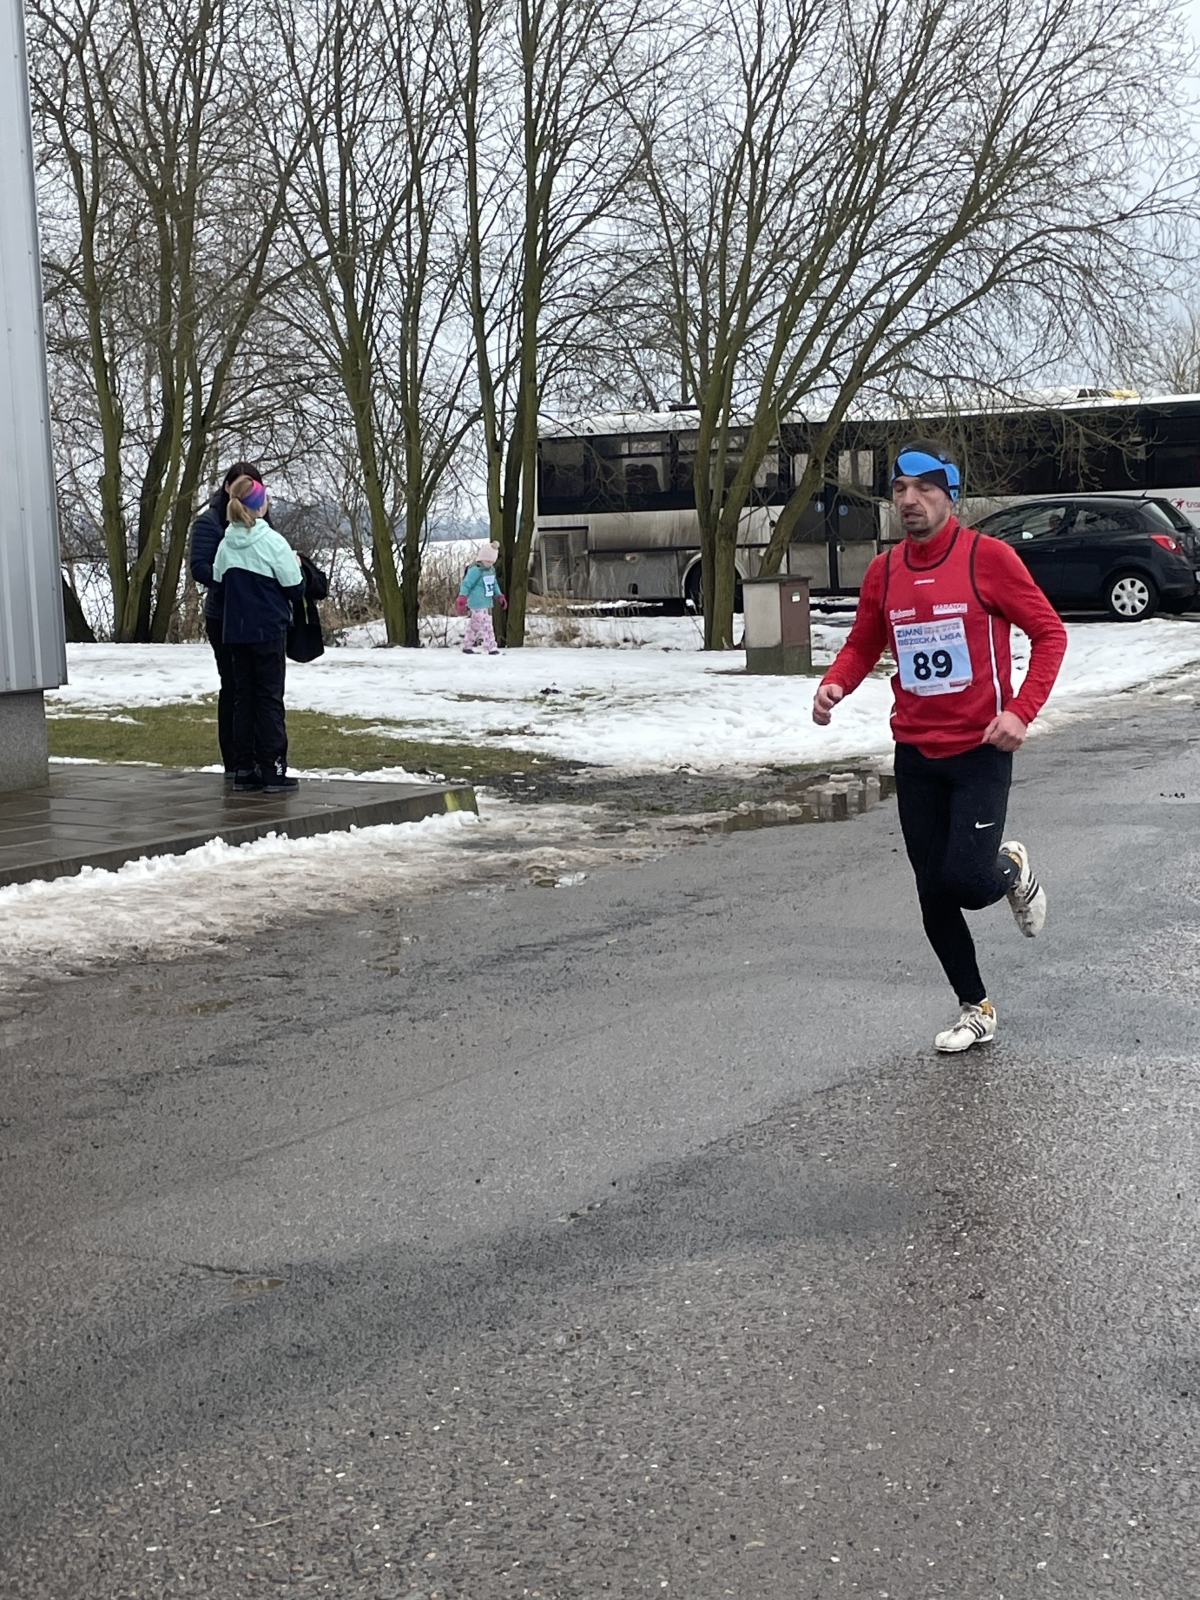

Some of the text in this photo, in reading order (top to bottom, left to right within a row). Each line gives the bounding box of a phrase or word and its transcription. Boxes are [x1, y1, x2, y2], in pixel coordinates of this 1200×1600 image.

[896, 626, 923, 638] ZIMNÍ
[939, 632, 962, 641] LIGA
[913, 650, 952, 680] 89
